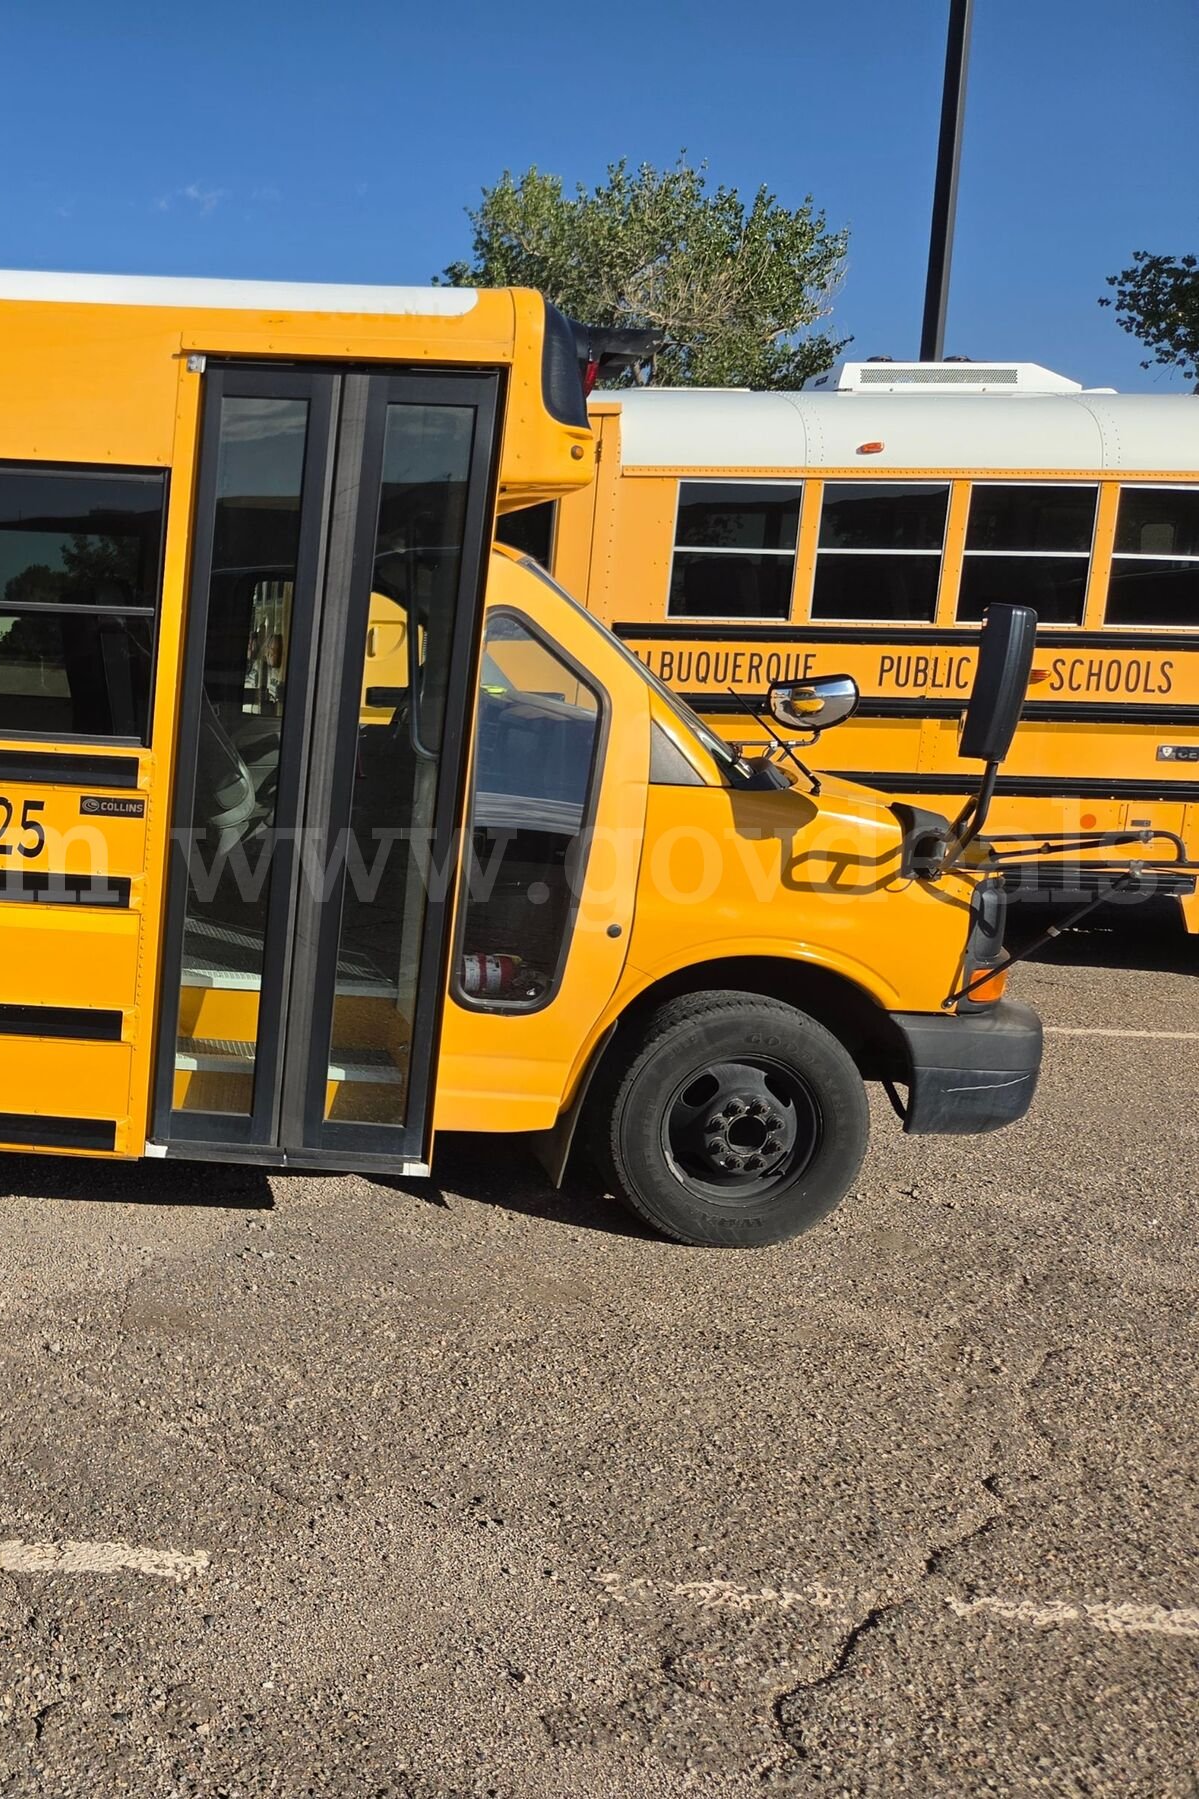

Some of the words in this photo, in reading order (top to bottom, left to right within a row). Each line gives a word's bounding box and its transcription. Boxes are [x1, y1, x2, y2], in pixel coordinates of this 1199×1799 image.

[633, 650, 817, 684] BUQUERQUE
[878, 655, 971, 690] PUBLIC
[1050, 658, 1174, 694] SCHOOLS
[100, 801, 144, 813] COLLINS
